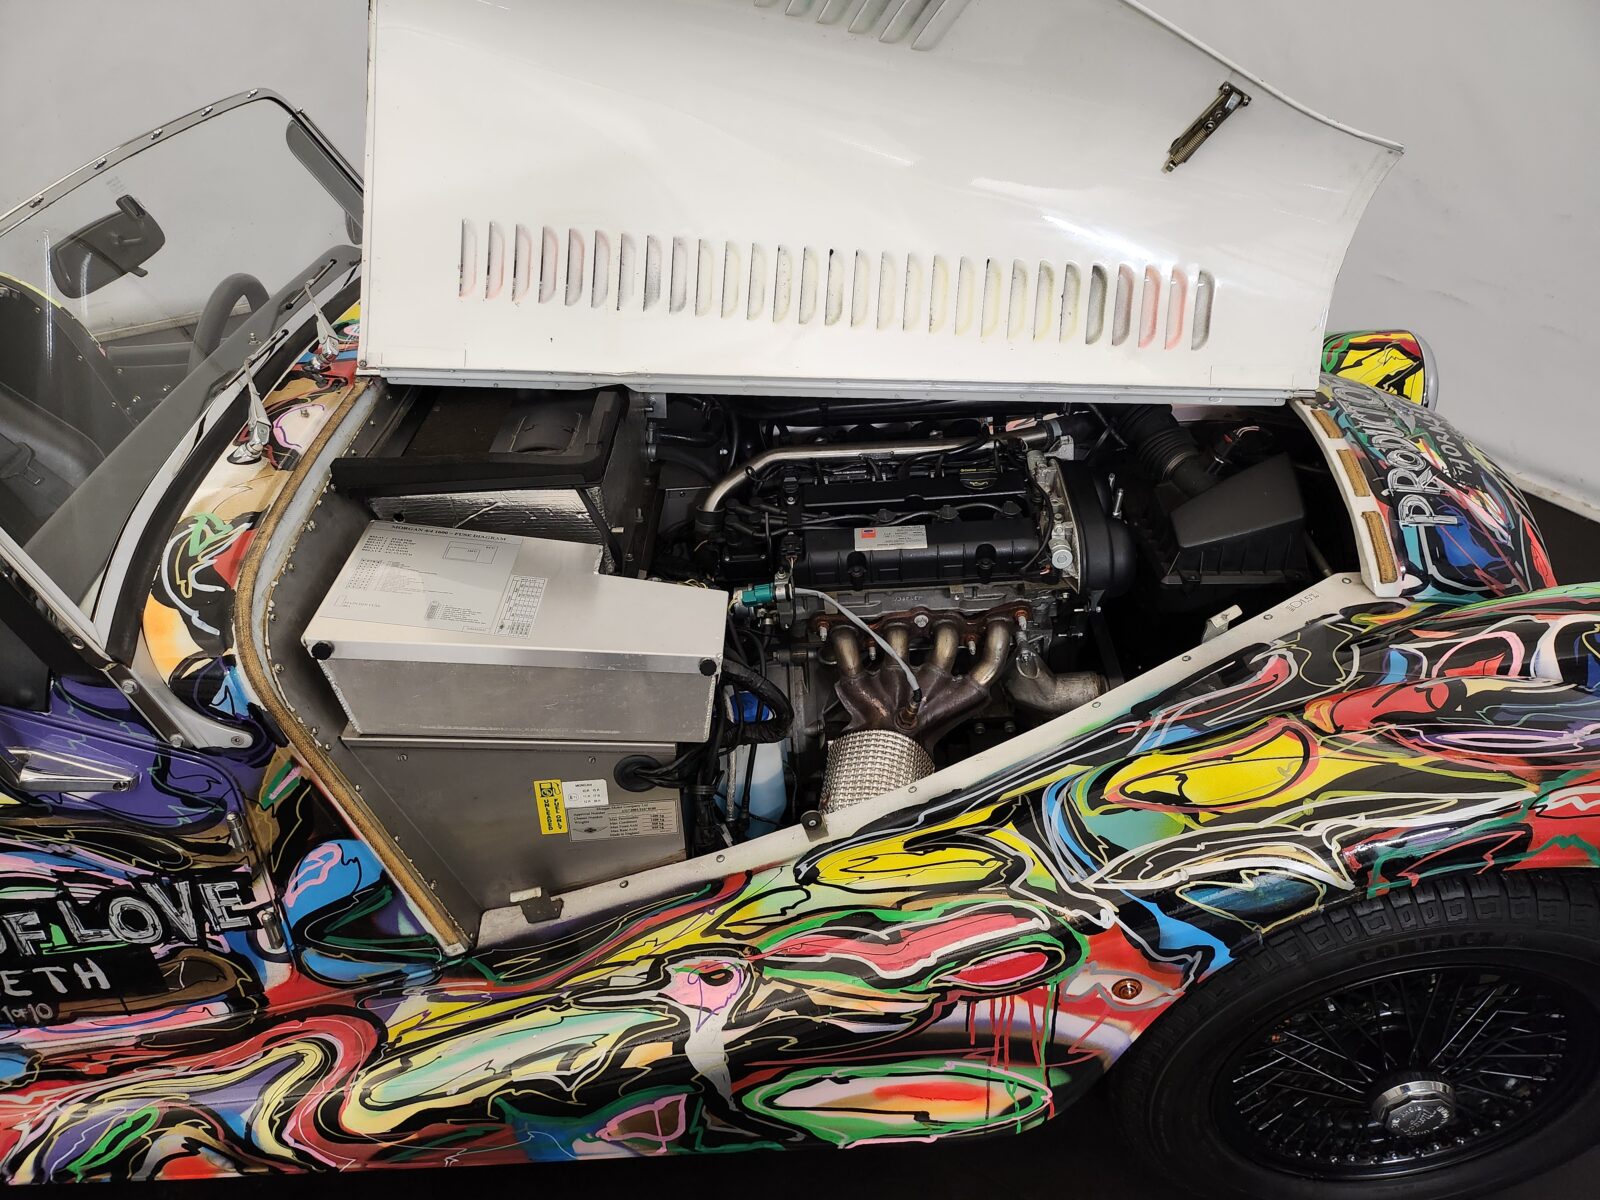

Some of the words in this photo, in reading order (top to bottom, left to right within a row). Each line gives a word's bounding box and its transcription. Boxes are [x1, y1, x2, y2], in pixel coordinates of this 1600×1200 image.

[391, 524, 423, 533] MORGAN
[473, 533, 507, 542] DIAGRAM
[544, 799, 553, 831] UNLEADED
[0, 911, 47, 957] F
[57, 881, 252, 945] LOVE
